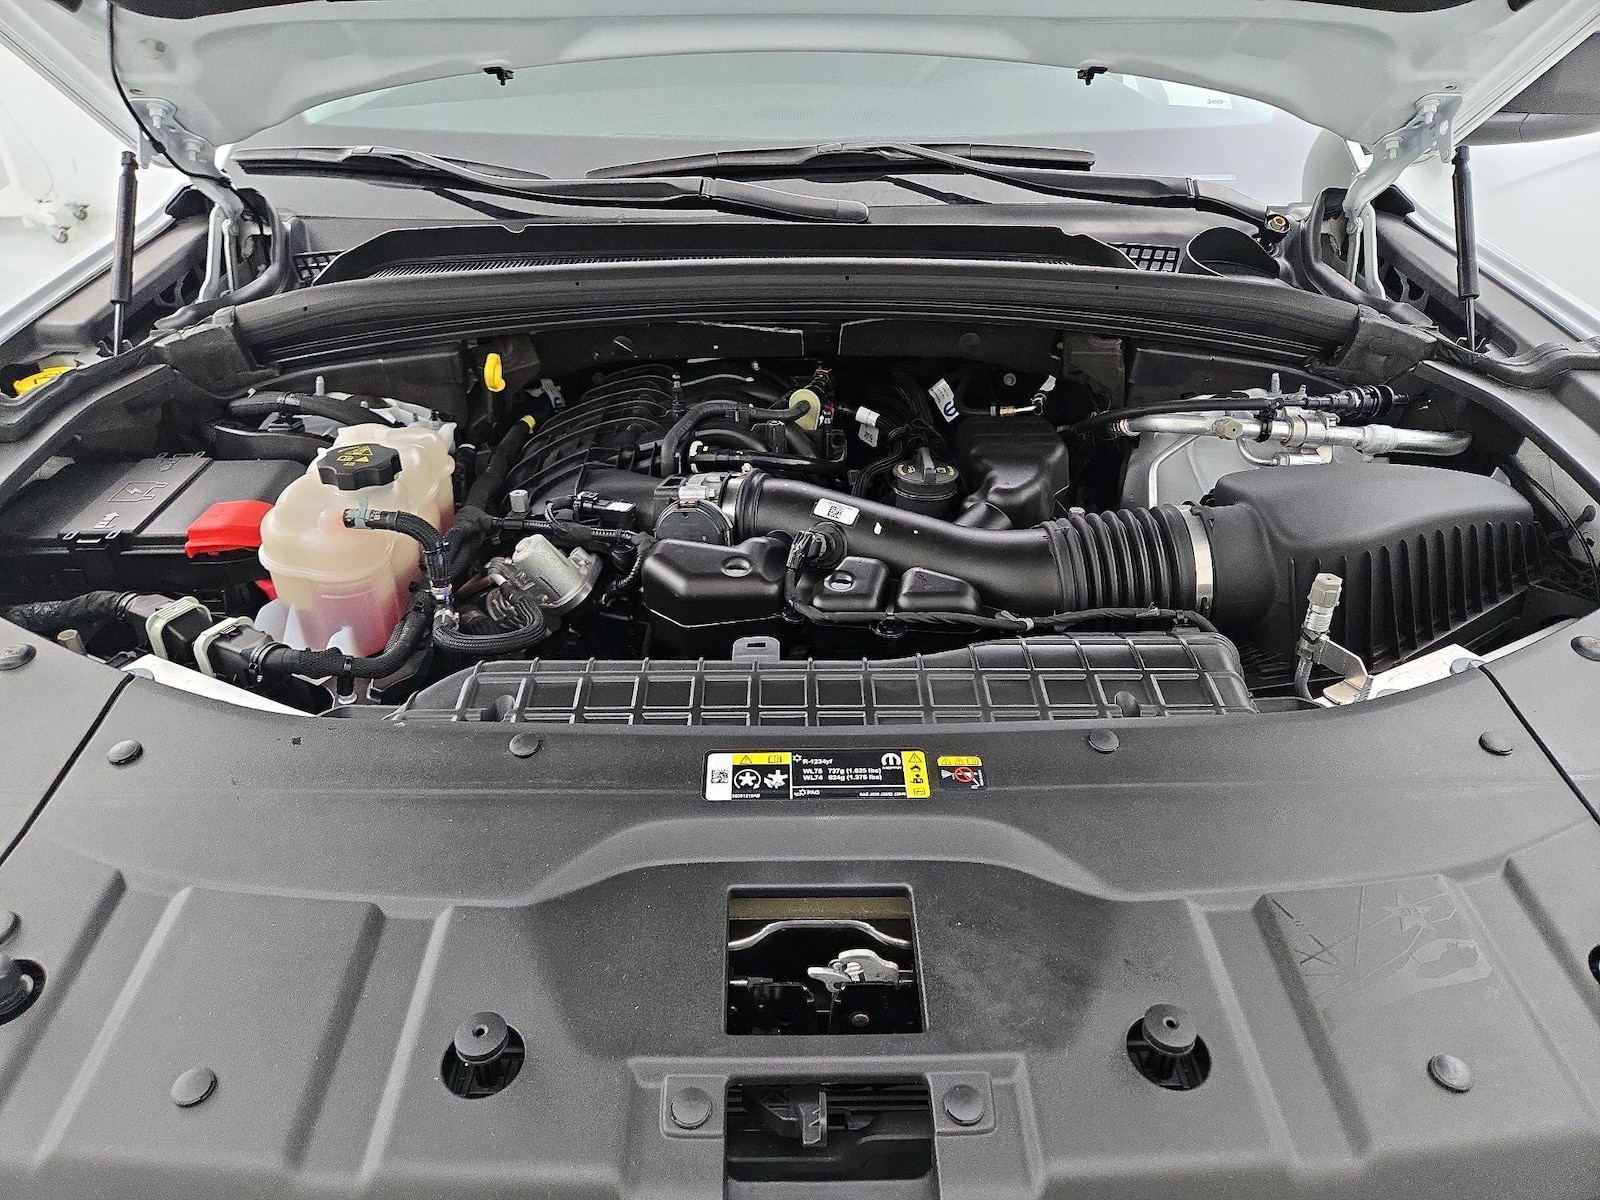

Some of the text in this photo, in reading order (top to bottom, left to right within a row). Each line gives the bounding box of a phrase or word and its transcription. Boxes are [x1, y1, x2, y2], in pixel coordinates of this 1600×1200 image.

[802, 758, 833, 766] R-1234yf
[827, 767, 845, 775] 737g
[845, 767, 868, 775] (1.625
[868, 767, 881, 775] lbs)
[827, 774, 845, 782] 624g
